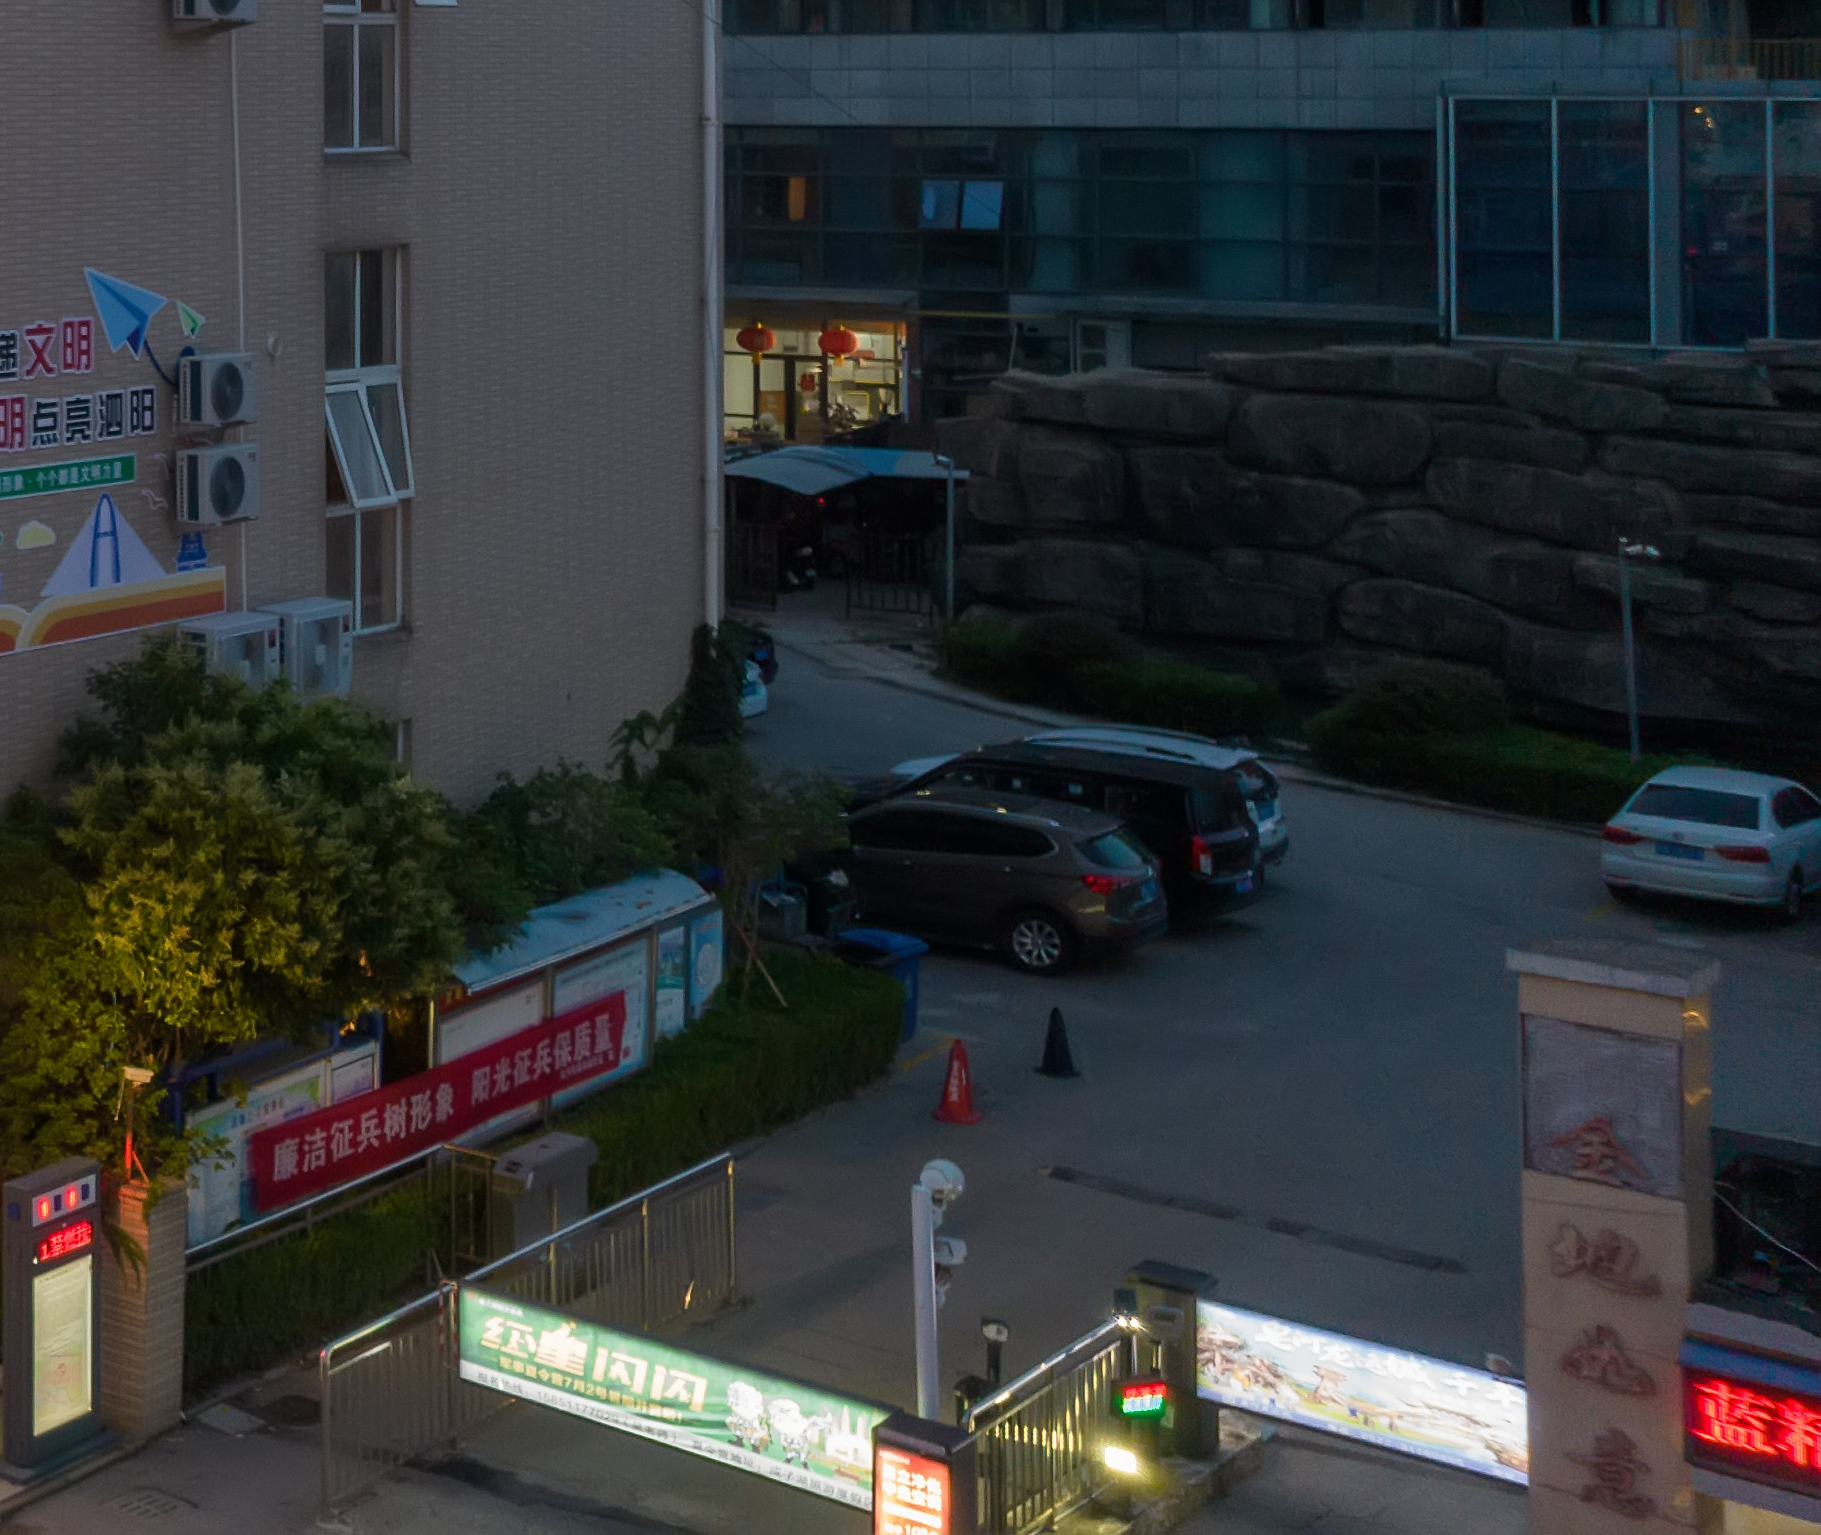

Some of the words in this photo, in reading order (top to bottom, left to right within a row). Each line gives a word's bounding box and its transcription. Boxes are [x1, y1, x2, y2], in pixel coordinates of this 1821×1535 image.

[272, 1082, 455, 1184] 廉洁征兵树形象
[469, 1014, 614, 1107] 阳光征兵保质量
